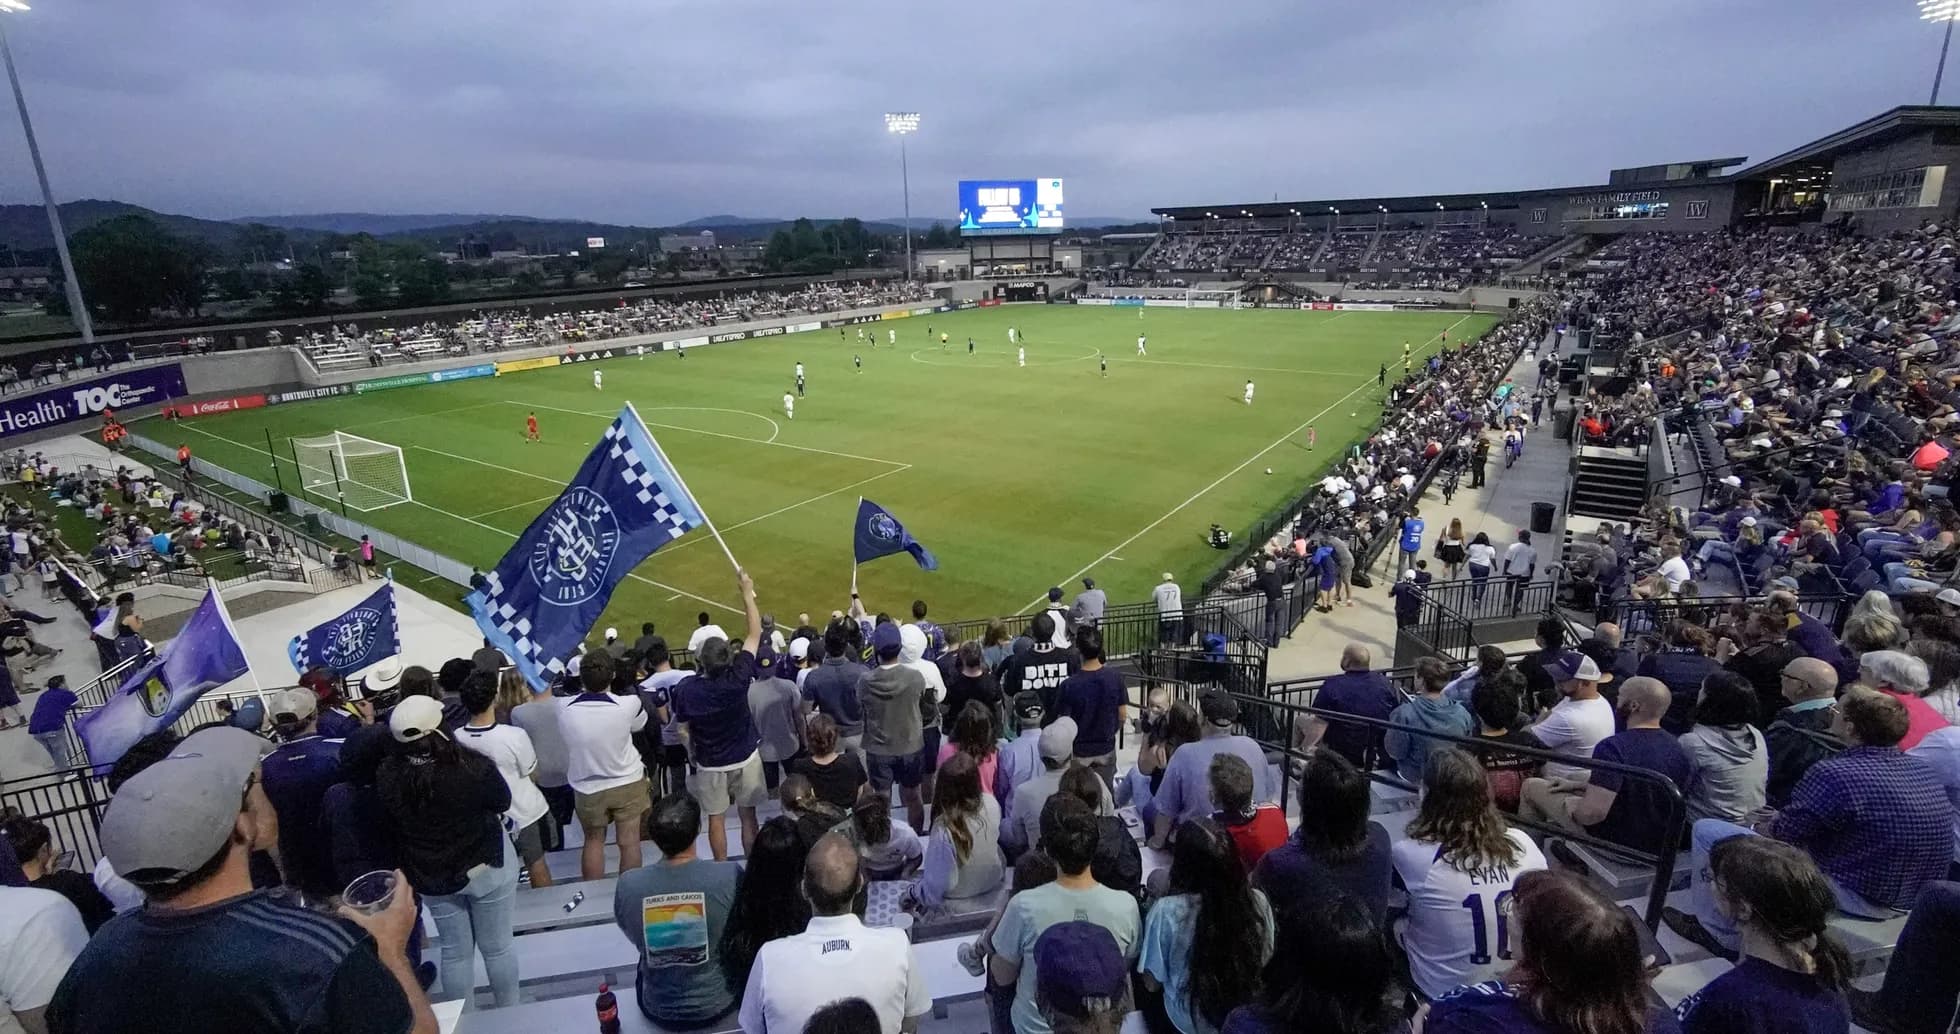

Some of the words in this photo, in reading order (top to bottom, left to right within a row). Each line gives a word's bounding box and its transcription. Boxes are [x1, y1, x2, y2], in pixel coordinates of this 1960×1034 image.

[1569, 196, 1597, 205] WICKS
[1598, 192, 1631, 203] FAMILY
[1632, 190, 1660, 201] FIELD
[1689, 204, 1704, 216] W
[73, 383, 122, 415] TOC
[281, 390, 316, 402] HUNTSVILLE
[316, 387, 331, 399] CITY
[331, 386, 339, 396] FC
[0, 399, 66, 433] Health
[1164, 590, 1177, 601] 77
[645, 896, 665, 905] TURKS
[680, 893, 703, 901] CAICOS
[821, 938, 850, 955] AUBURN
